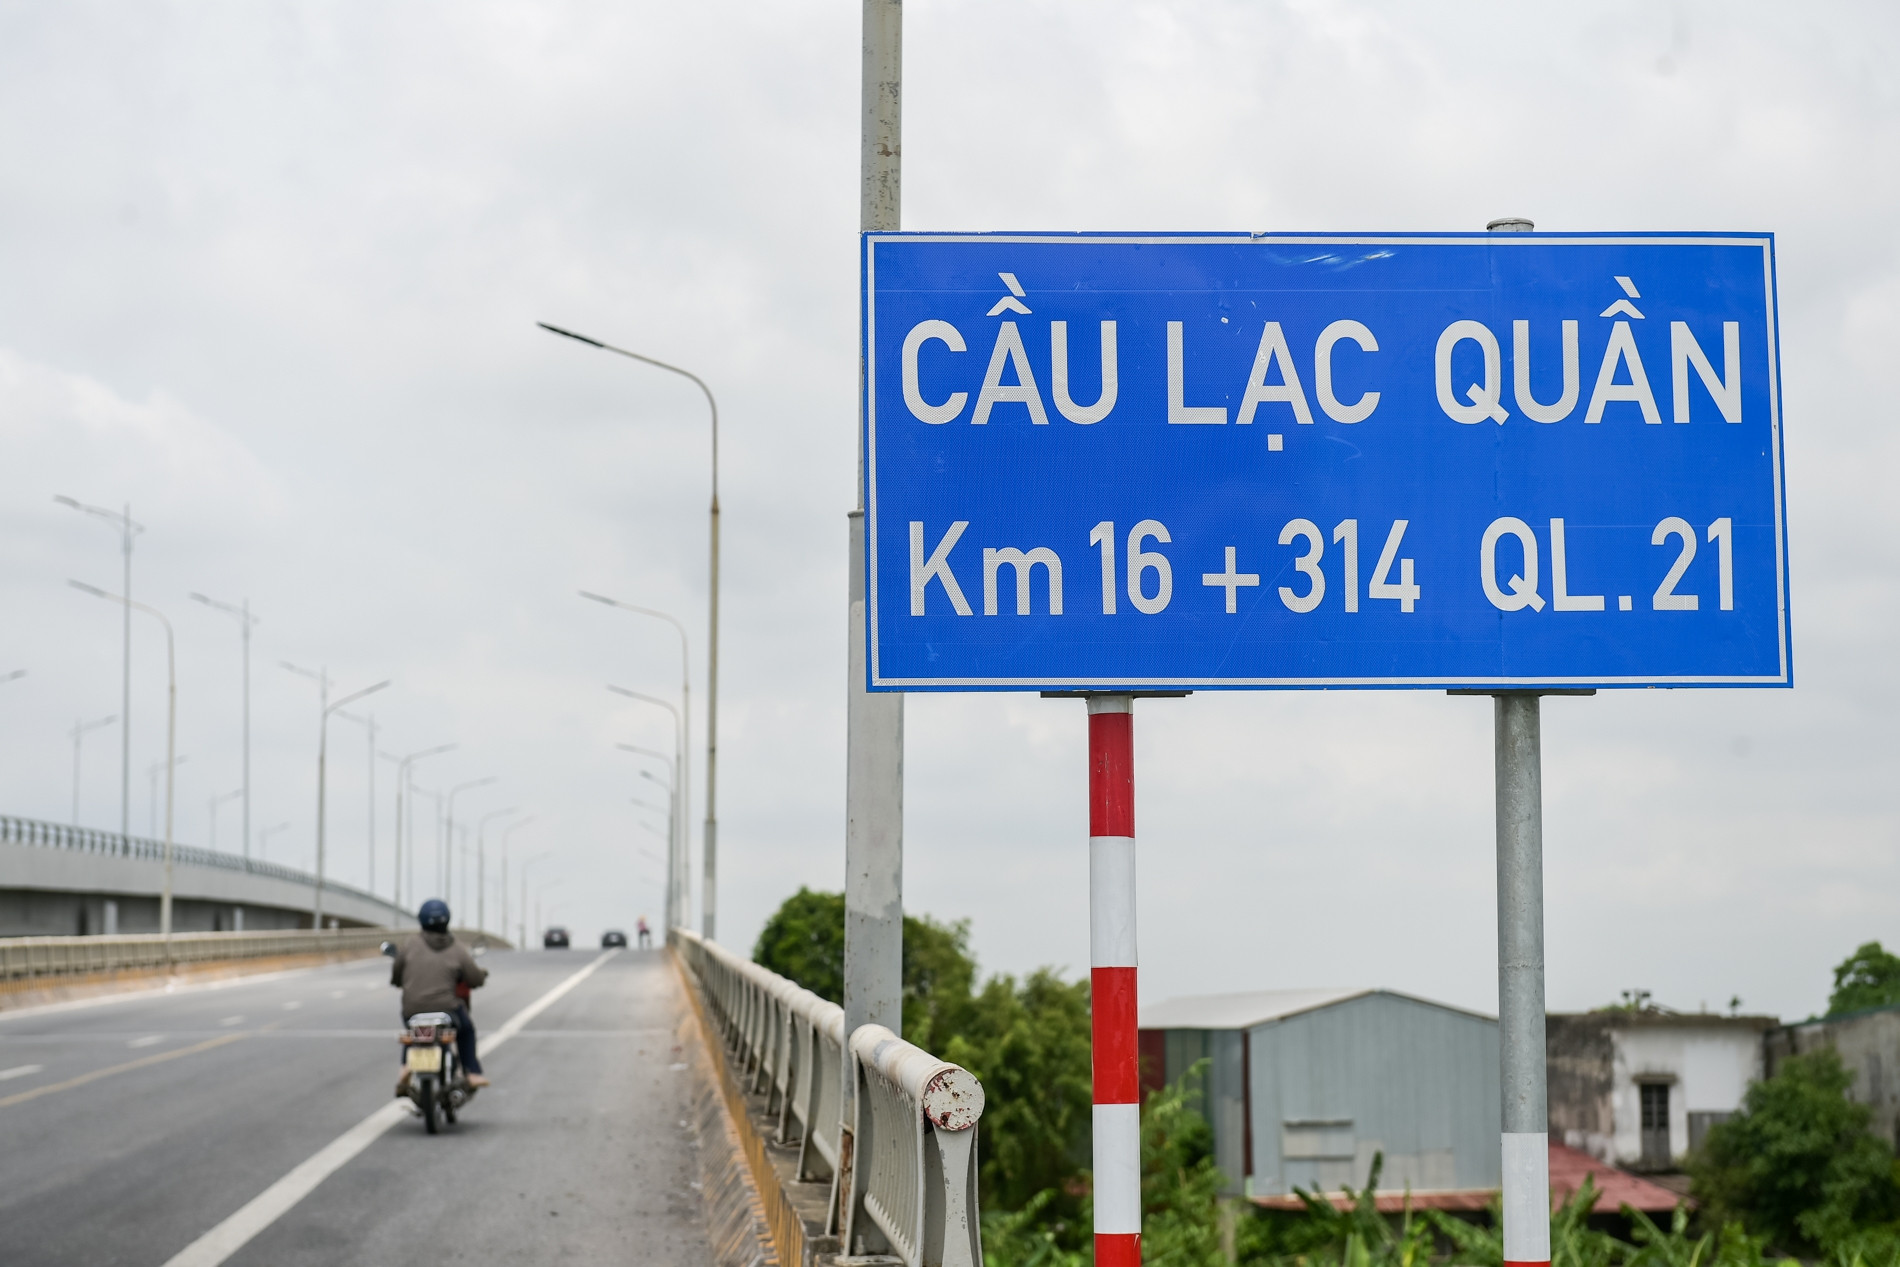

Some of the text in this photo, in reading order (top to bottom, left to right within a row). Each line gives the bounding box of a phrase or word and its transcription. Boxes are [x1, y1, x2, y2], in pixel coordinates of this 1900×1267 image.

[901, 272, 1742, 452] CẦU LẠC QUẦN
[909, 520, 1063, 617] Km
[1089, 519, 1173, 615] 16
